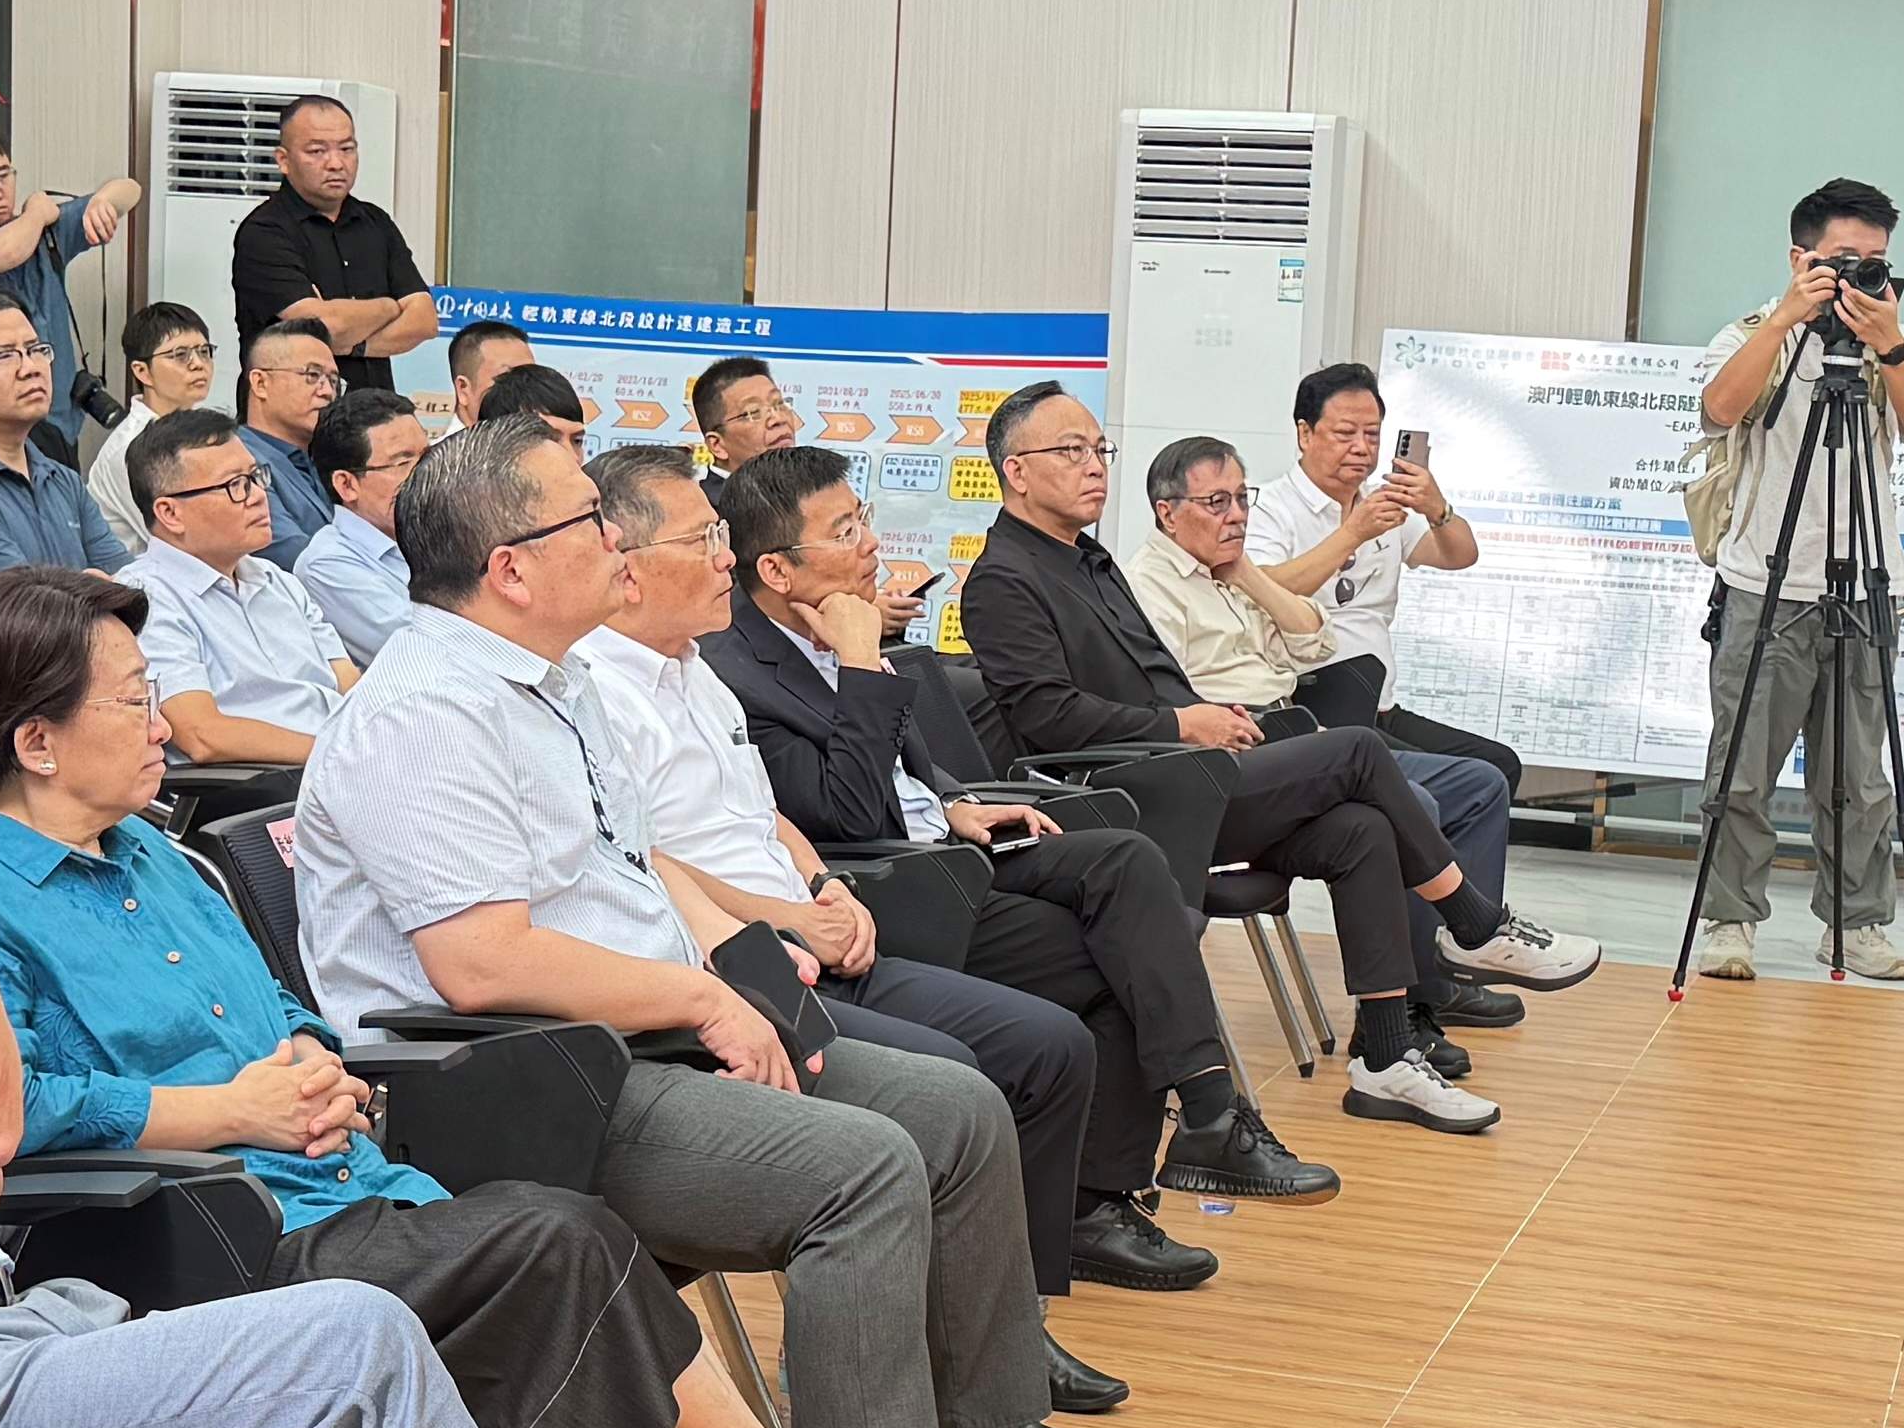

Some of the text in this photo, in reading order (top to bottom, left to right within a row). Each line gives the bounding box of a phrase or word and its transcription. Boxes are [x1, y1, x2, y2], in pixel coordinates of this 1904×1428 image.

[1527, 385, 1702, 413] 澳門輕軌東線北段隧
